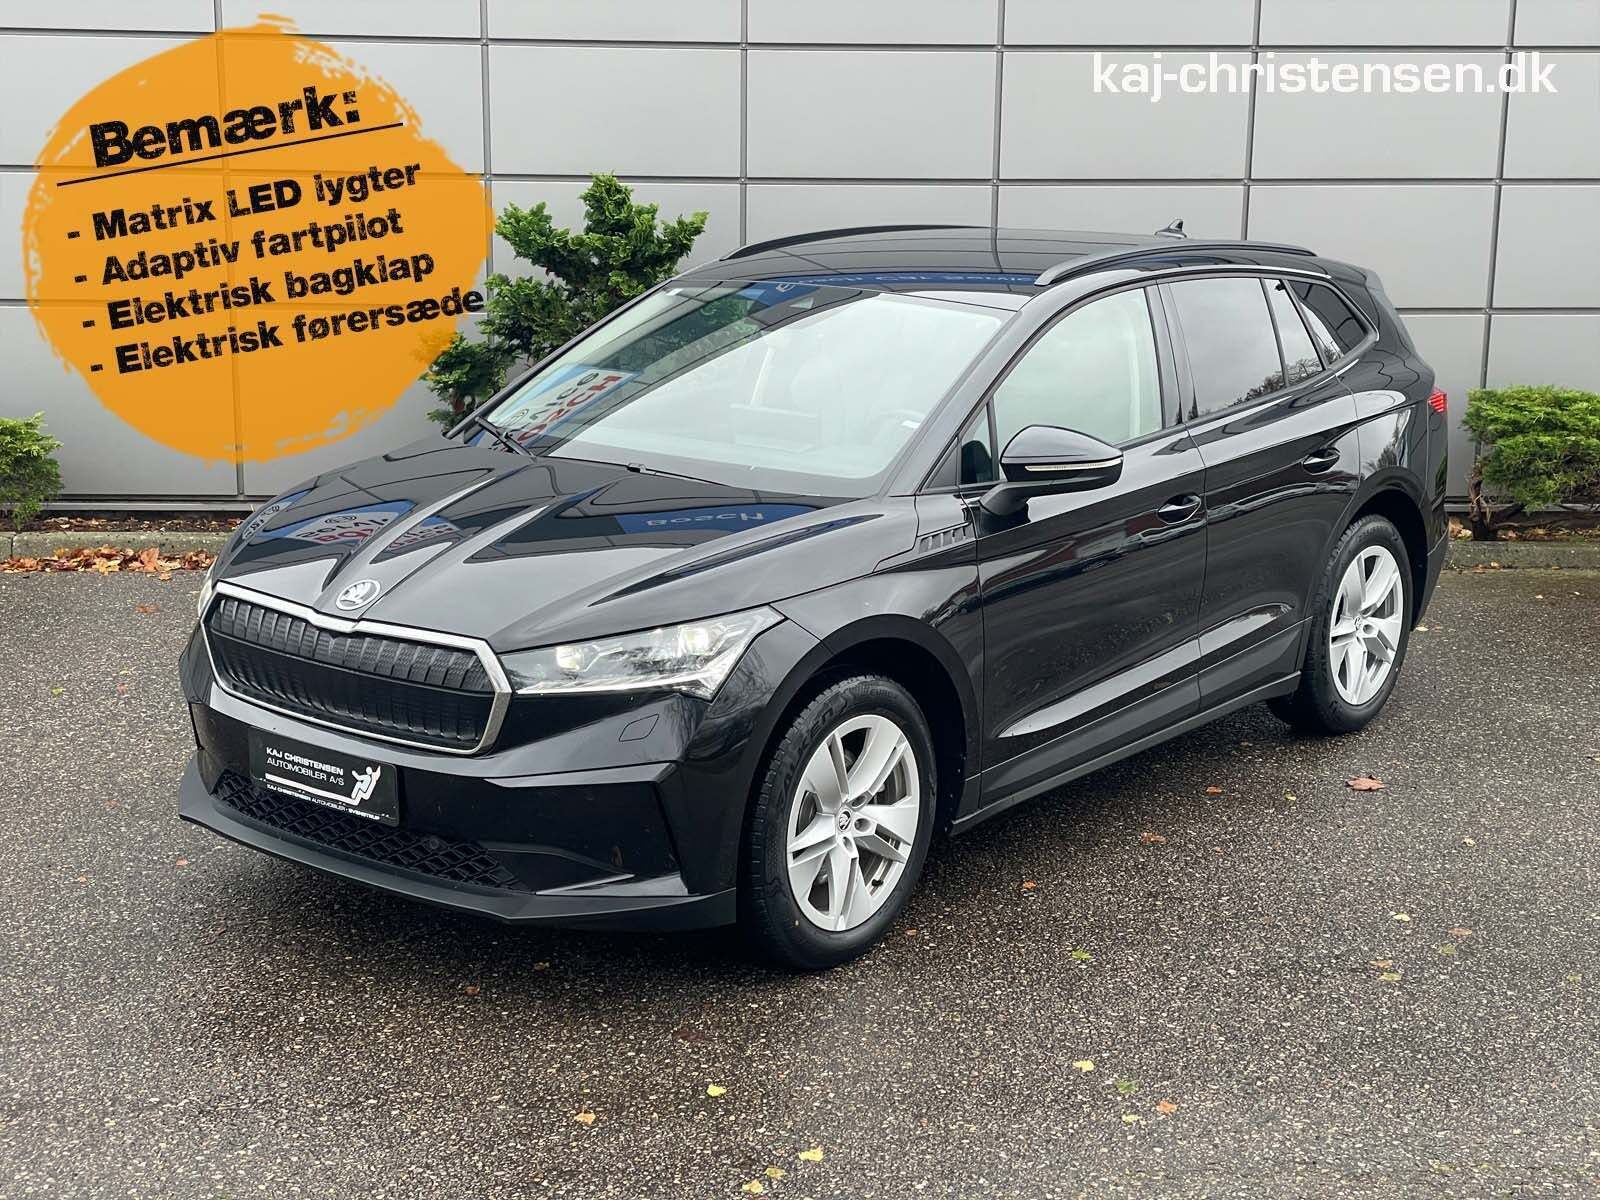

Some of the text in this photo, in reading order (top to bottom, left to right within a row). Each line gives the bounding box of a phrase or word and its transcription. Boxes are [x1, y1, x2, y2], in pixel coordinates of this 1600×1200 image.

[266, 746, 344, 776] KAJ CHRISTENSEN
[266, 757, 345, 786] AUTOMOBILER A/S
